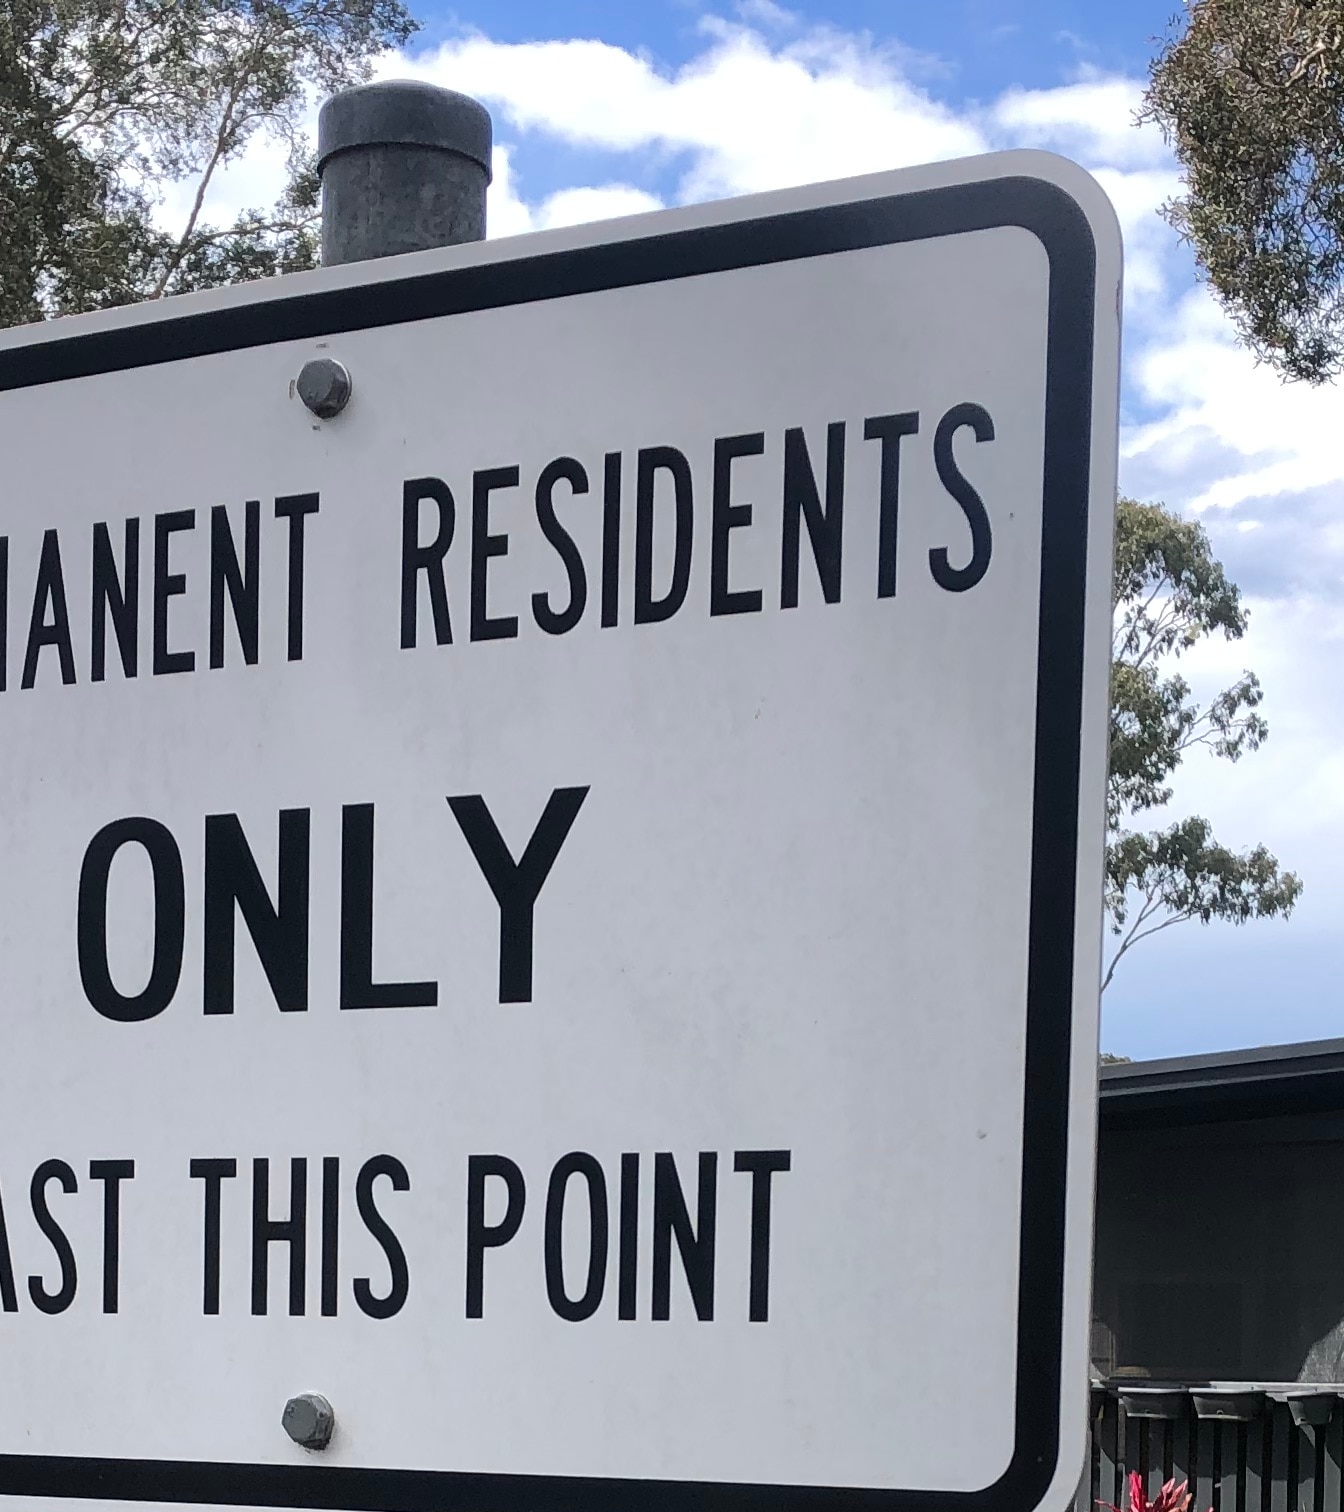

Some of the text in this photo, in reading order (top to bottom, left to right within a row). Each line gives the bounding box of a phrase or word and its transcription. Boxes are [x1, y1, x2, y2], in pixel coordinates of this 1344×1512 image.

[400, 401, 997, 651] RESIDENTS
[76, 784, 591, 1023] ONLY
[189, 1153, 411, 1319] THIS
[465, 1149, 793, 1323] POINT
